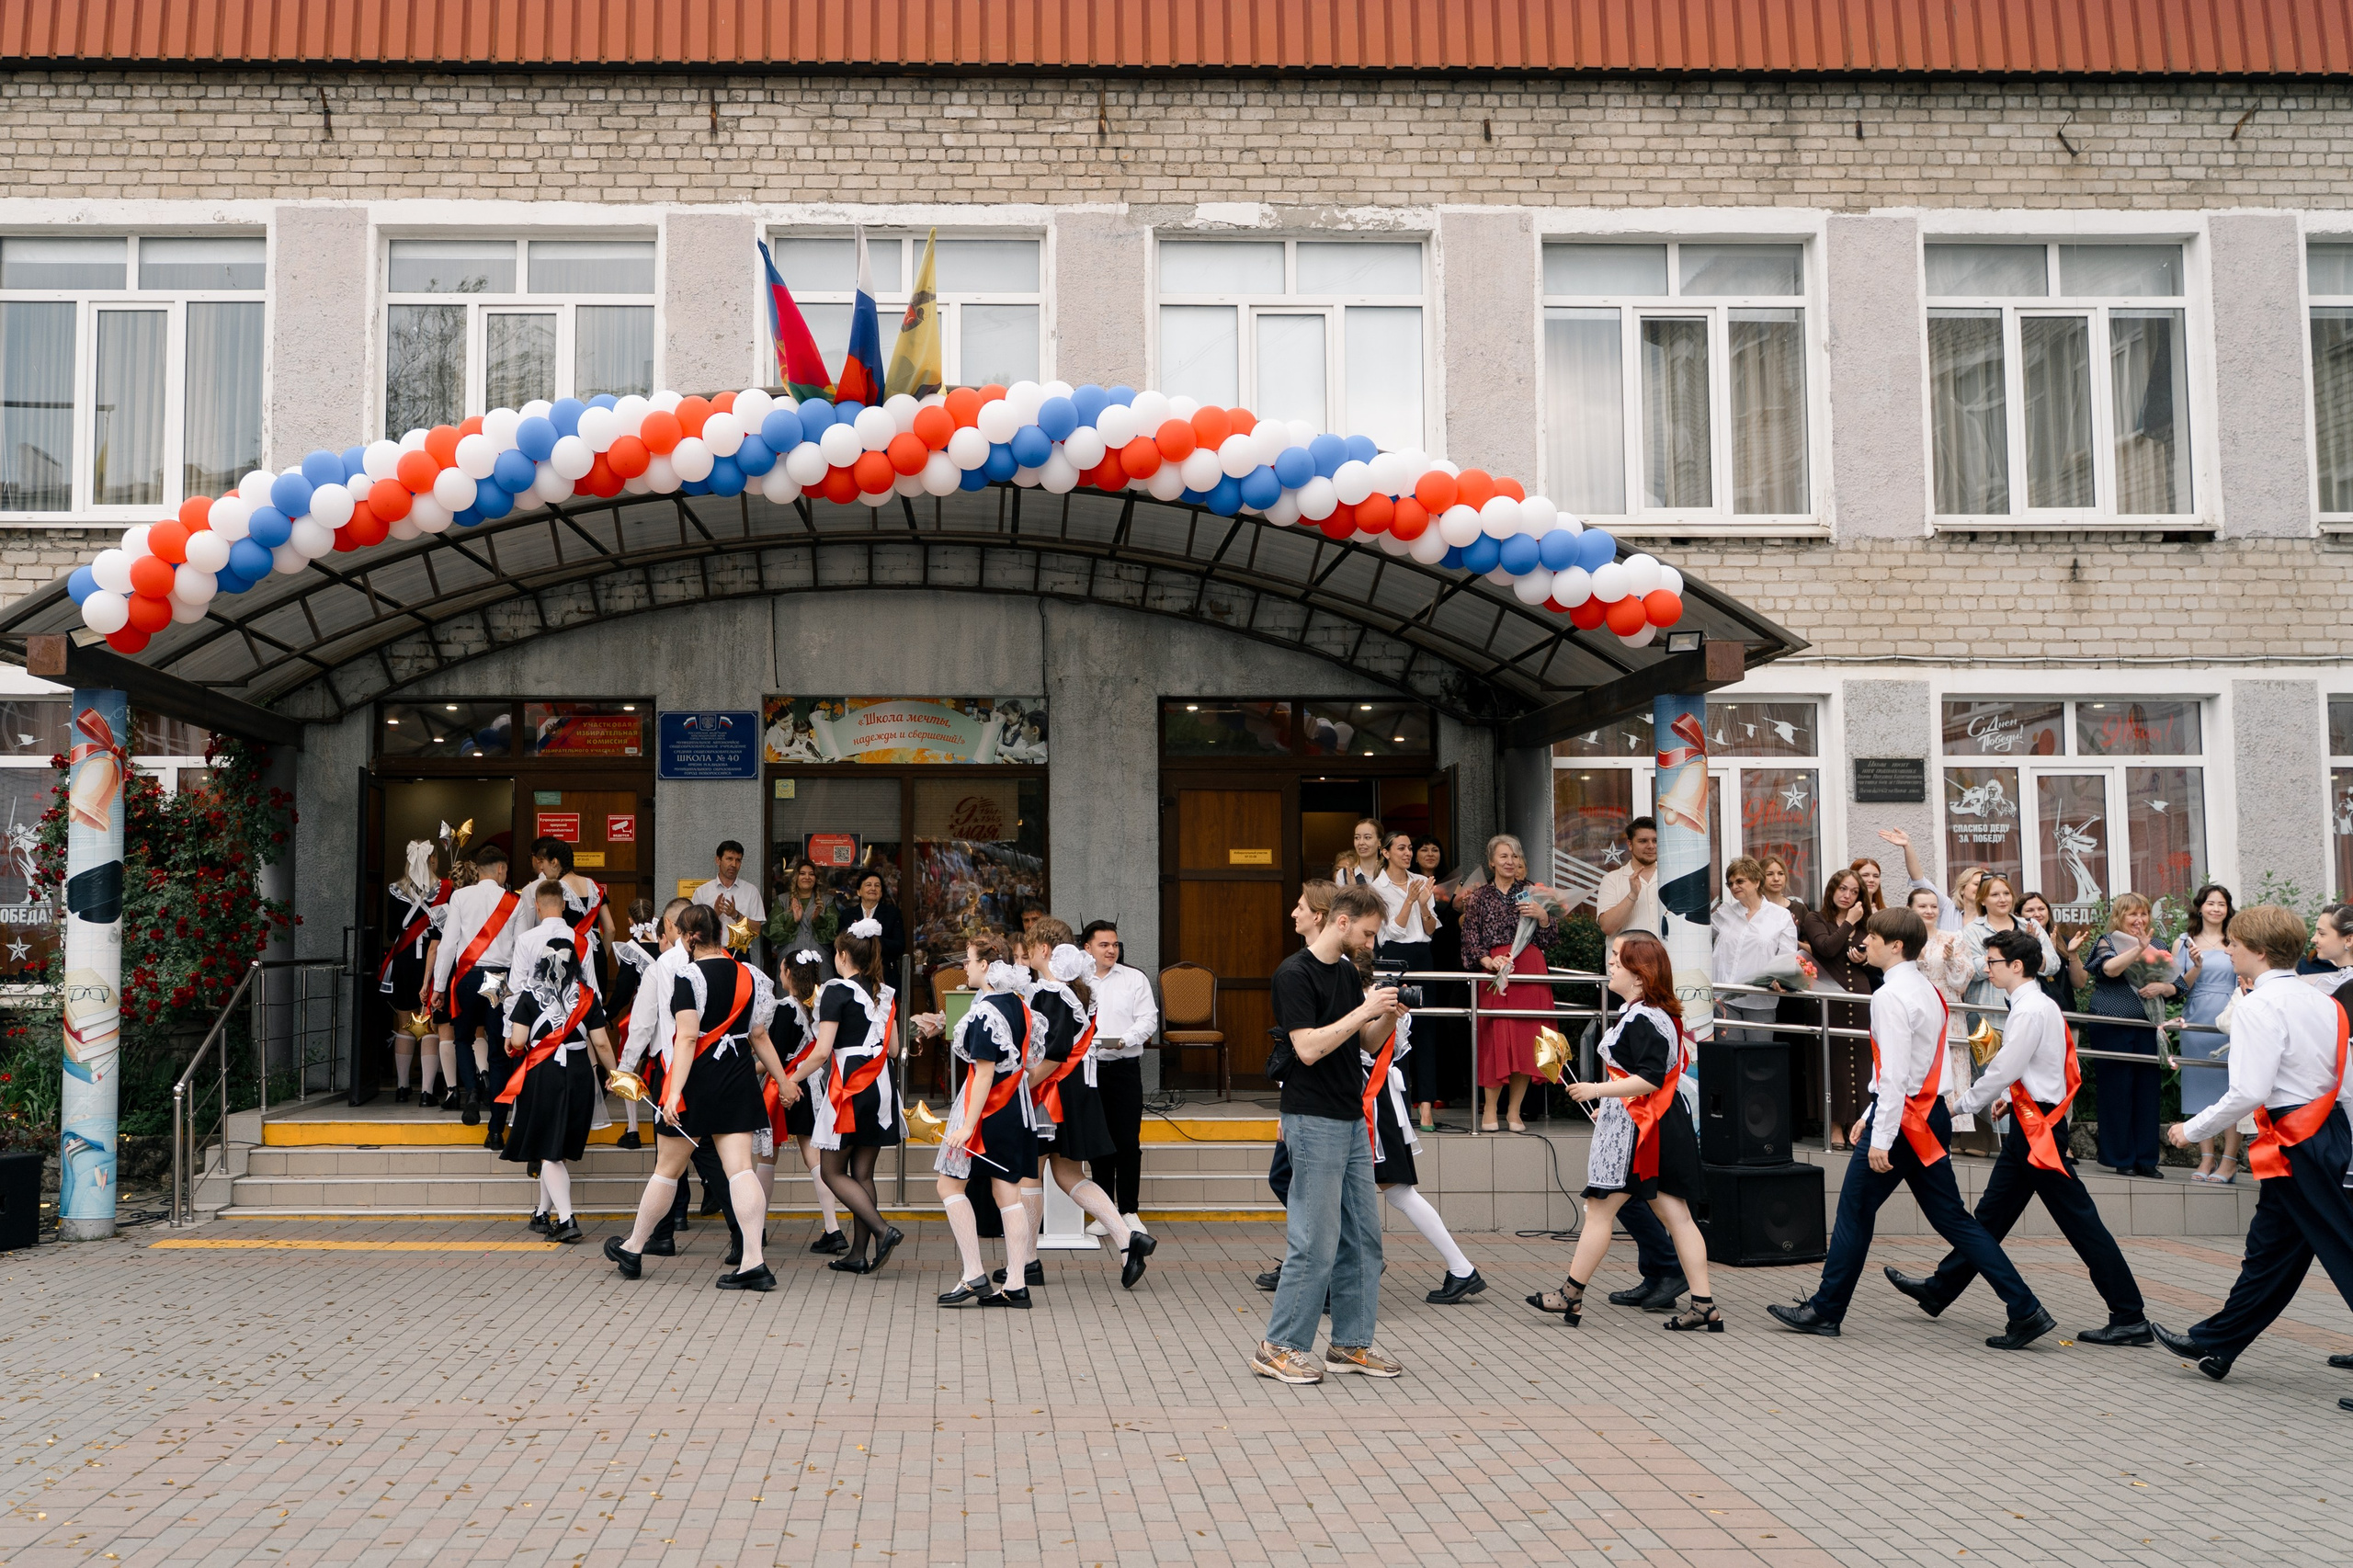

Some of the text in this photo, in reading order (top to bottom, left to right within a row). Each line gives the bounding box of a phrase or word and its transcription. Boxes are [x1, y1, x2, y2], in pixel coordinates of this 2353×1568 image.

[858, 711, 951, 728] «Школа мечты,
[1967, 714, 2018, 737] С Днем
[853, 731, 896, 746] надежды
[907, 729, 966, 745] свершений!»
[1977, 723, 2024, 753] Победы!
[2100, 715, 2122, 747] 9
[956, 796, 979, 825] 9
[1742, 797, 1764, 829] 9
[1952, 824, 2010, 834] СПАСИБО ДЕДУ
[1959, 834, 2006, 844] ЗА ПОБЕДУ!
[0, 908, 52, 926] ОБЕДА!
[2052, 908, 2103, 926] ОБЕДА!
